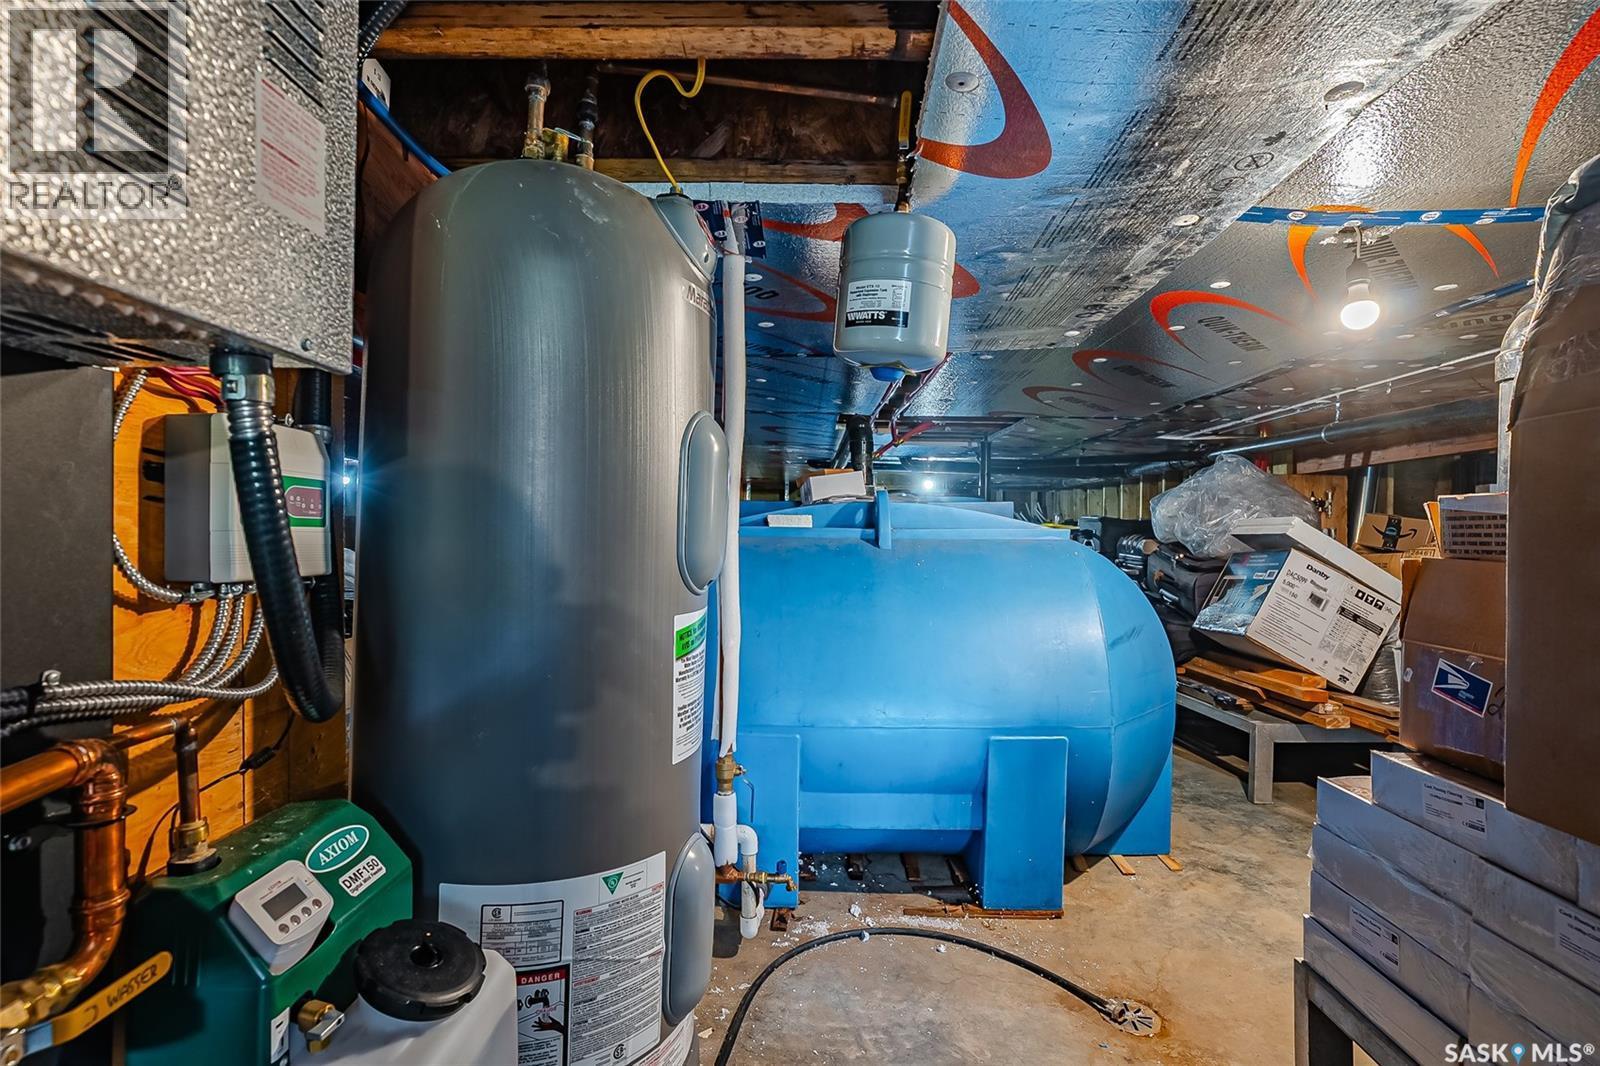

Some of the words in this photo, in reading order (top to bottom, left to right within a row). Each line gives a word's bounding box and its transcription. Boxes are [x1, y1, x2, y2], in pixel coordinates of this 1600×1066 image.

[1306, 564, 1331, 580] Danby
[318, 830, 359, 866] AXIOM
[342, 858, 380, 889] DMF150
[521, 972, 561, 985] DANGER
